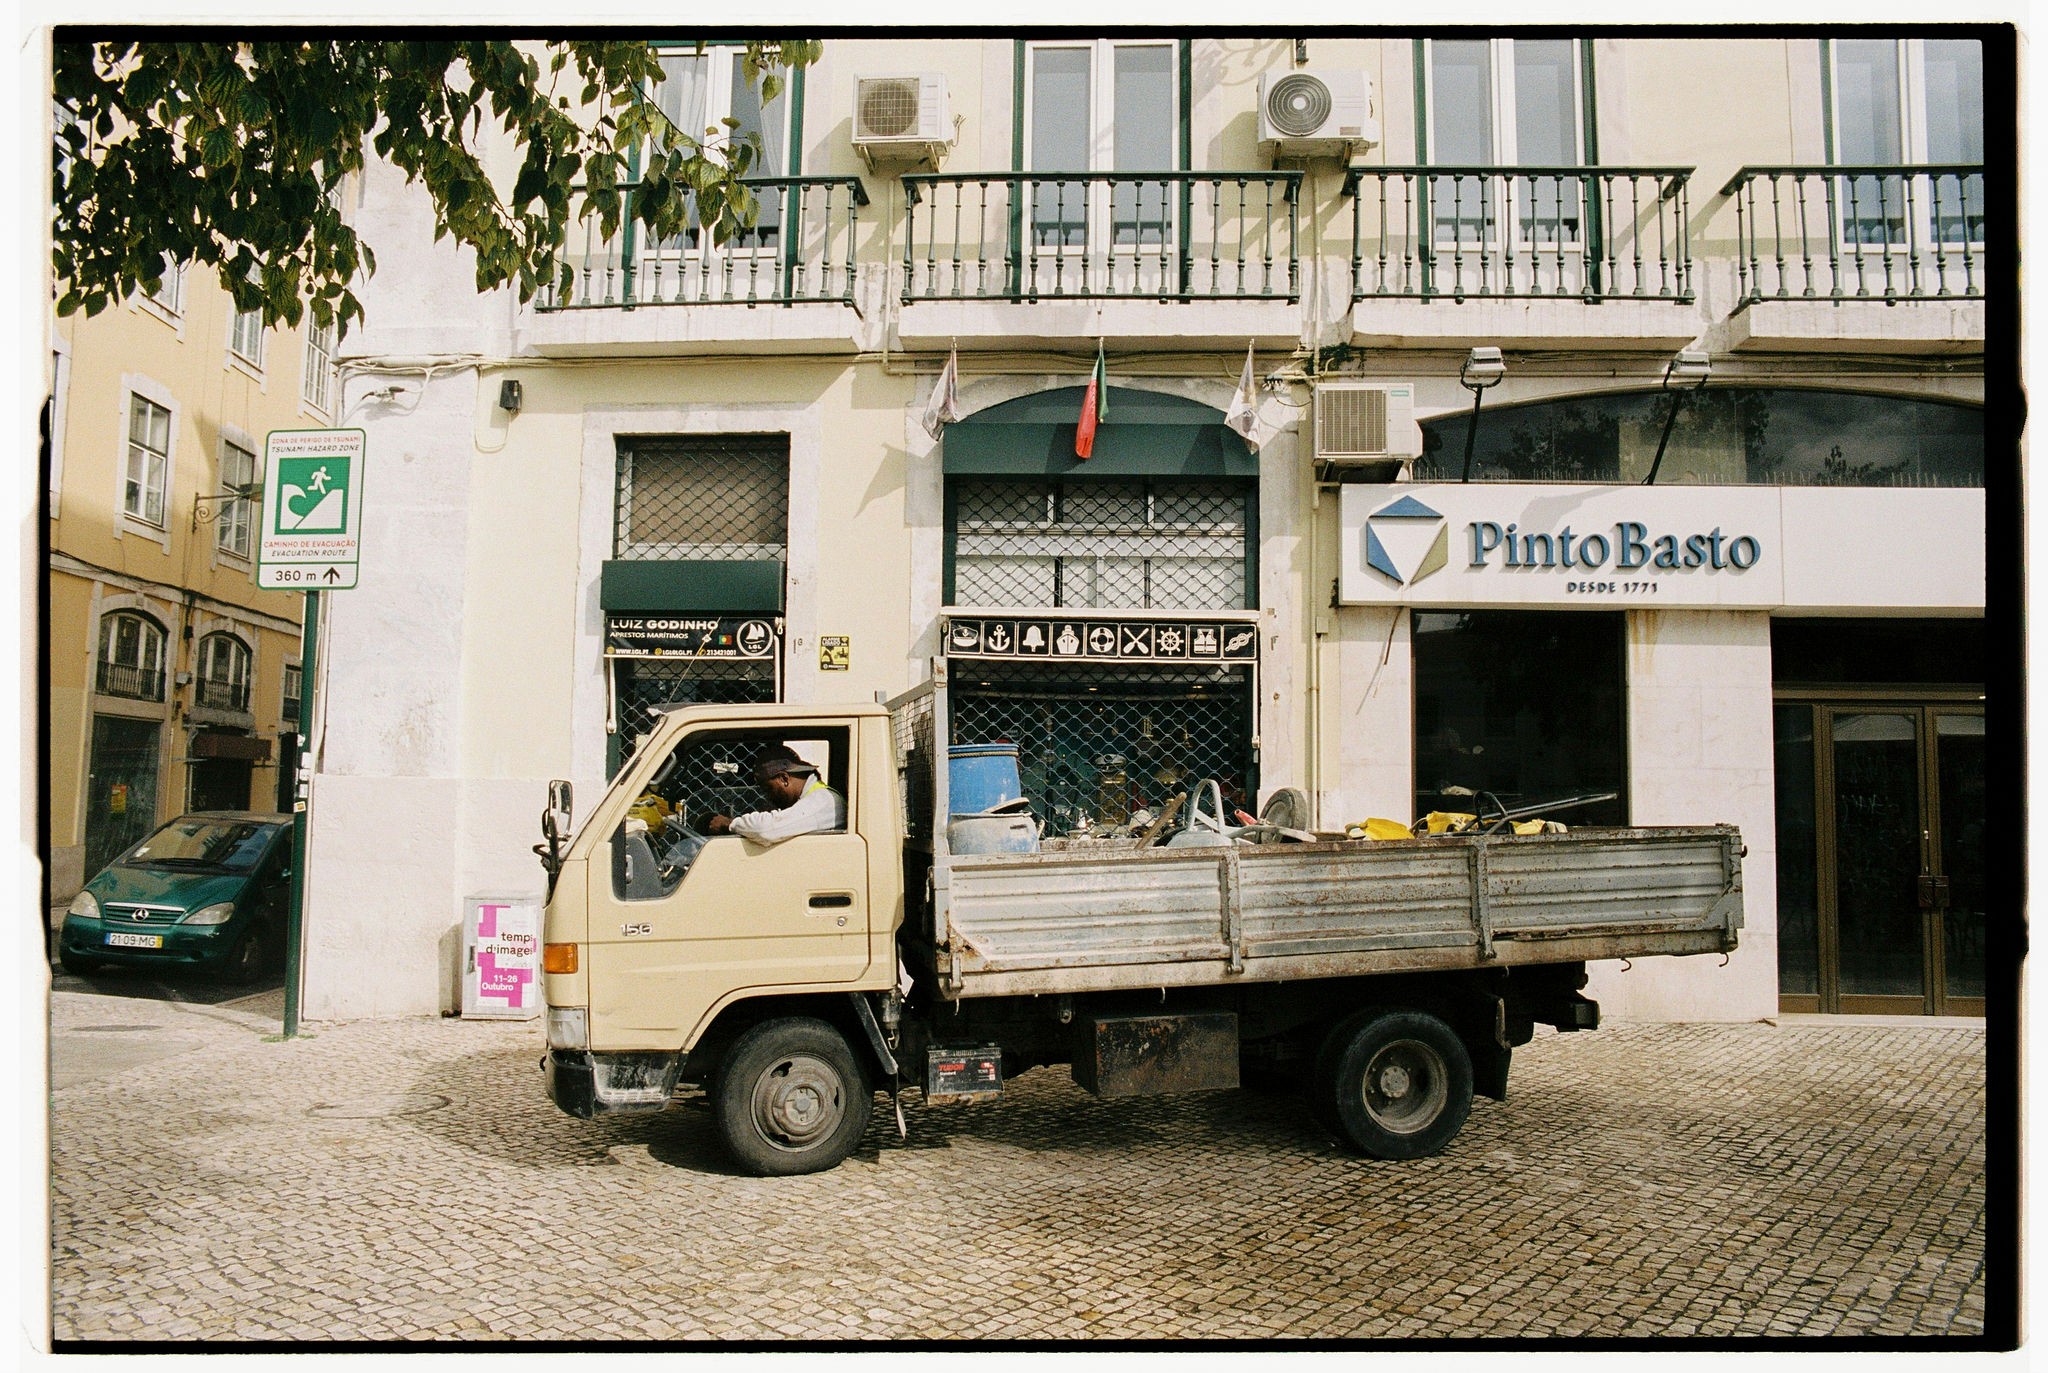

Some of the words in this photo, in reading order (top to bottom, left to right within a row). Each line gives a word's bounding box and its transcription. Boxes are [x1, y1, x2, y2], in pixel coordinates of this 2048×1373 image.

[312, 540, 356, 548] EVACUAÇÃO
[275, 570, 301, 581] 360
[306, 573, 316, 581] m
[1567, 582, 1616, 593] DESDE
[1624, 582, 1658, 593] 1771
[611, 619, 643, 629] LUIZ
[646, 620, 719, 630] GODINHO
[481, 982, 514, 991] Outubro
